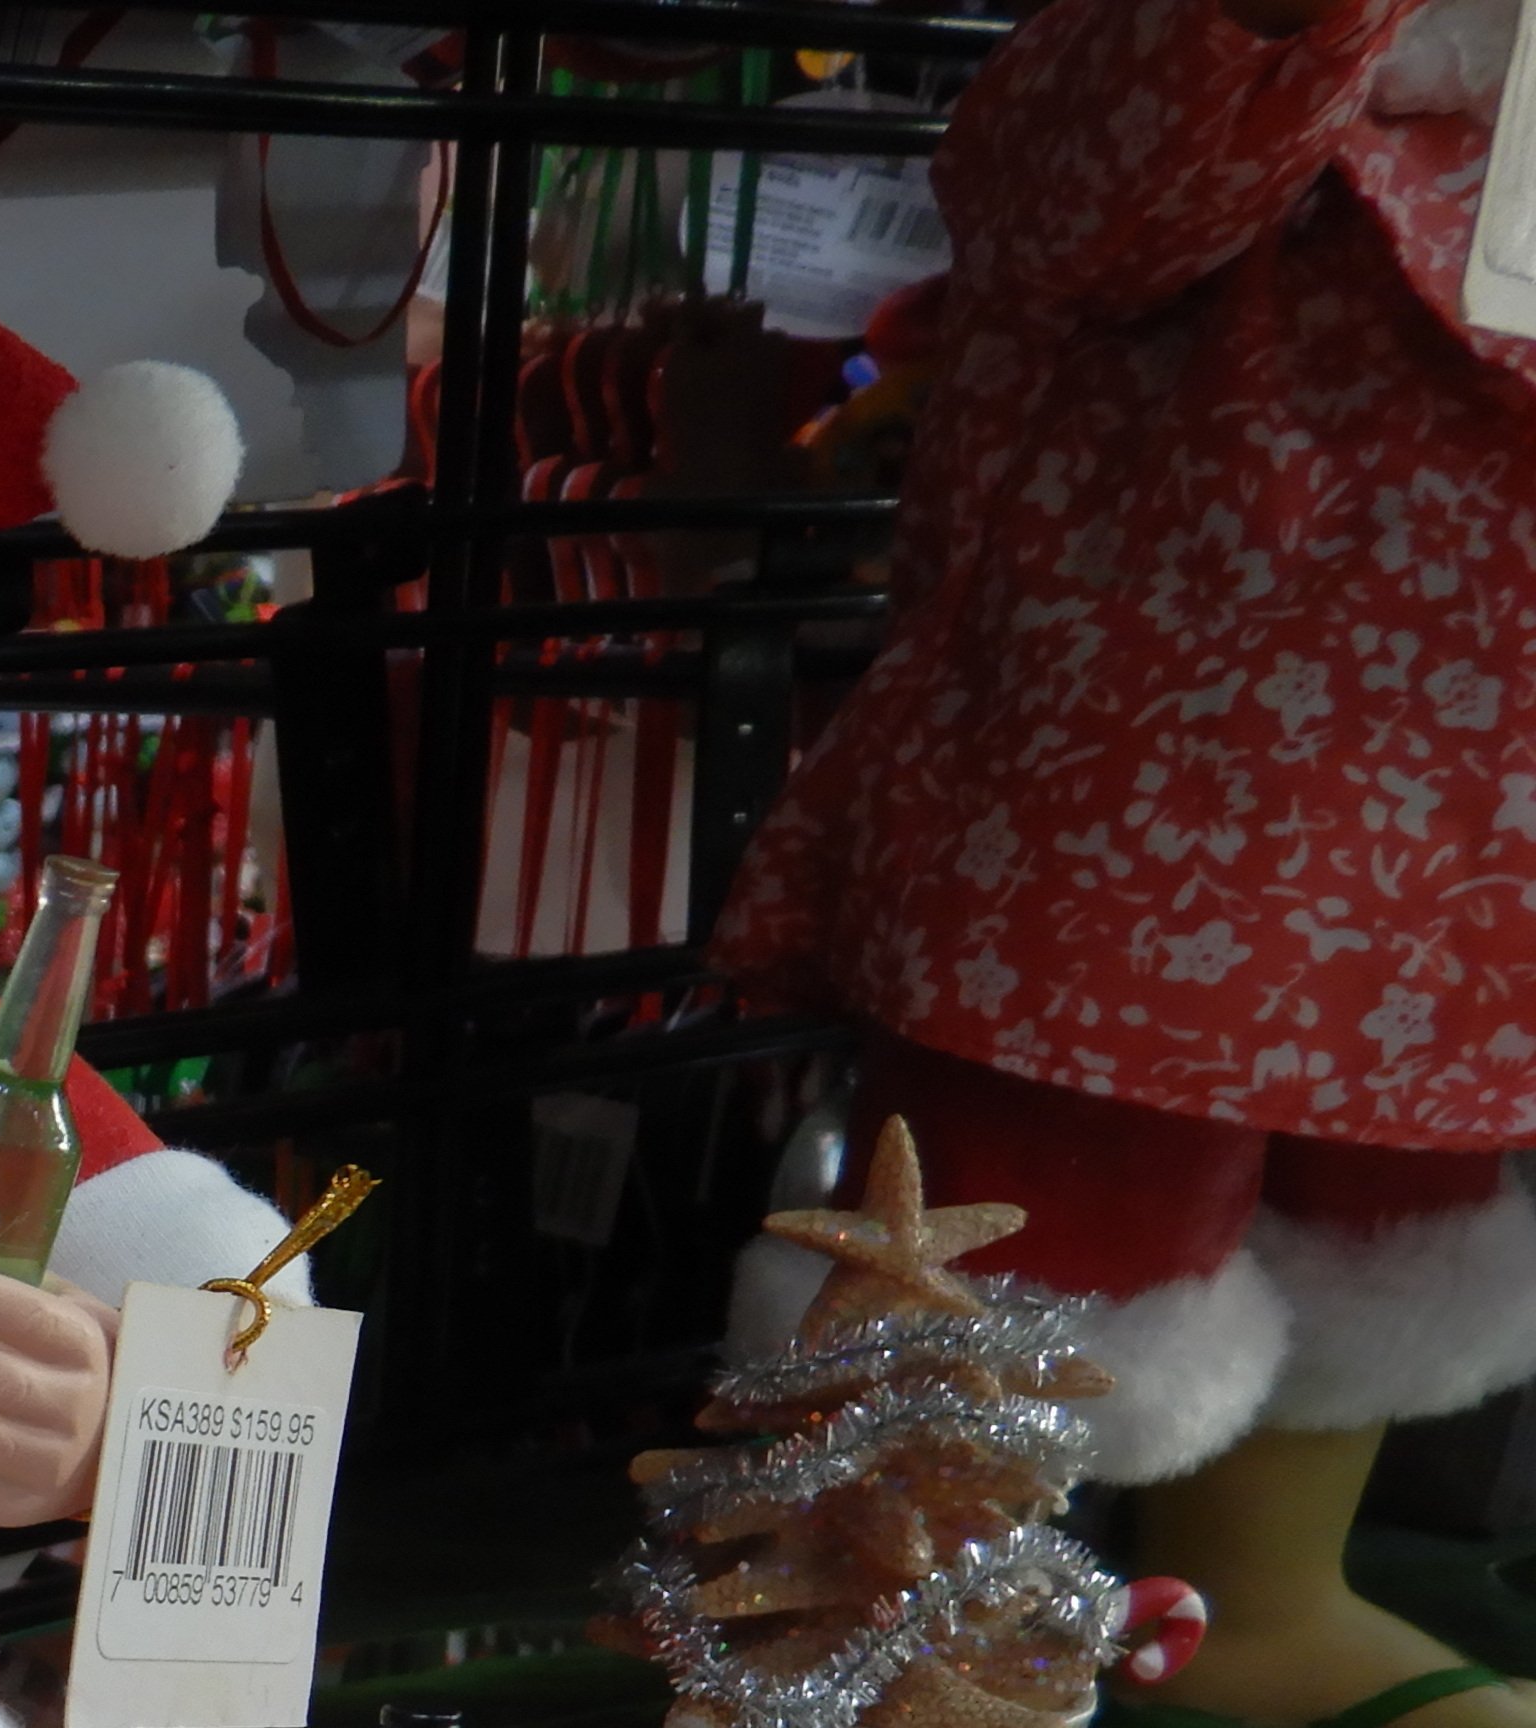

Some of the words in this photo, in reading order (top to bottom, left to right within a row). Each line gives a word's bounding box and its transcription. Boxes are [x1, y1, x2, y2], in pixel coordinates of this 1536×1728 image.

[138, 1397, 225, 1437] KSA389
[230, 1406, 316, 1446] $159.95
[110, 1570, 125, 1603] 7
[143, 1572, 205, 1605] 00859
[210, 1574, 272, 1608] 53779
[290, 1580, 304, 1608] 4
